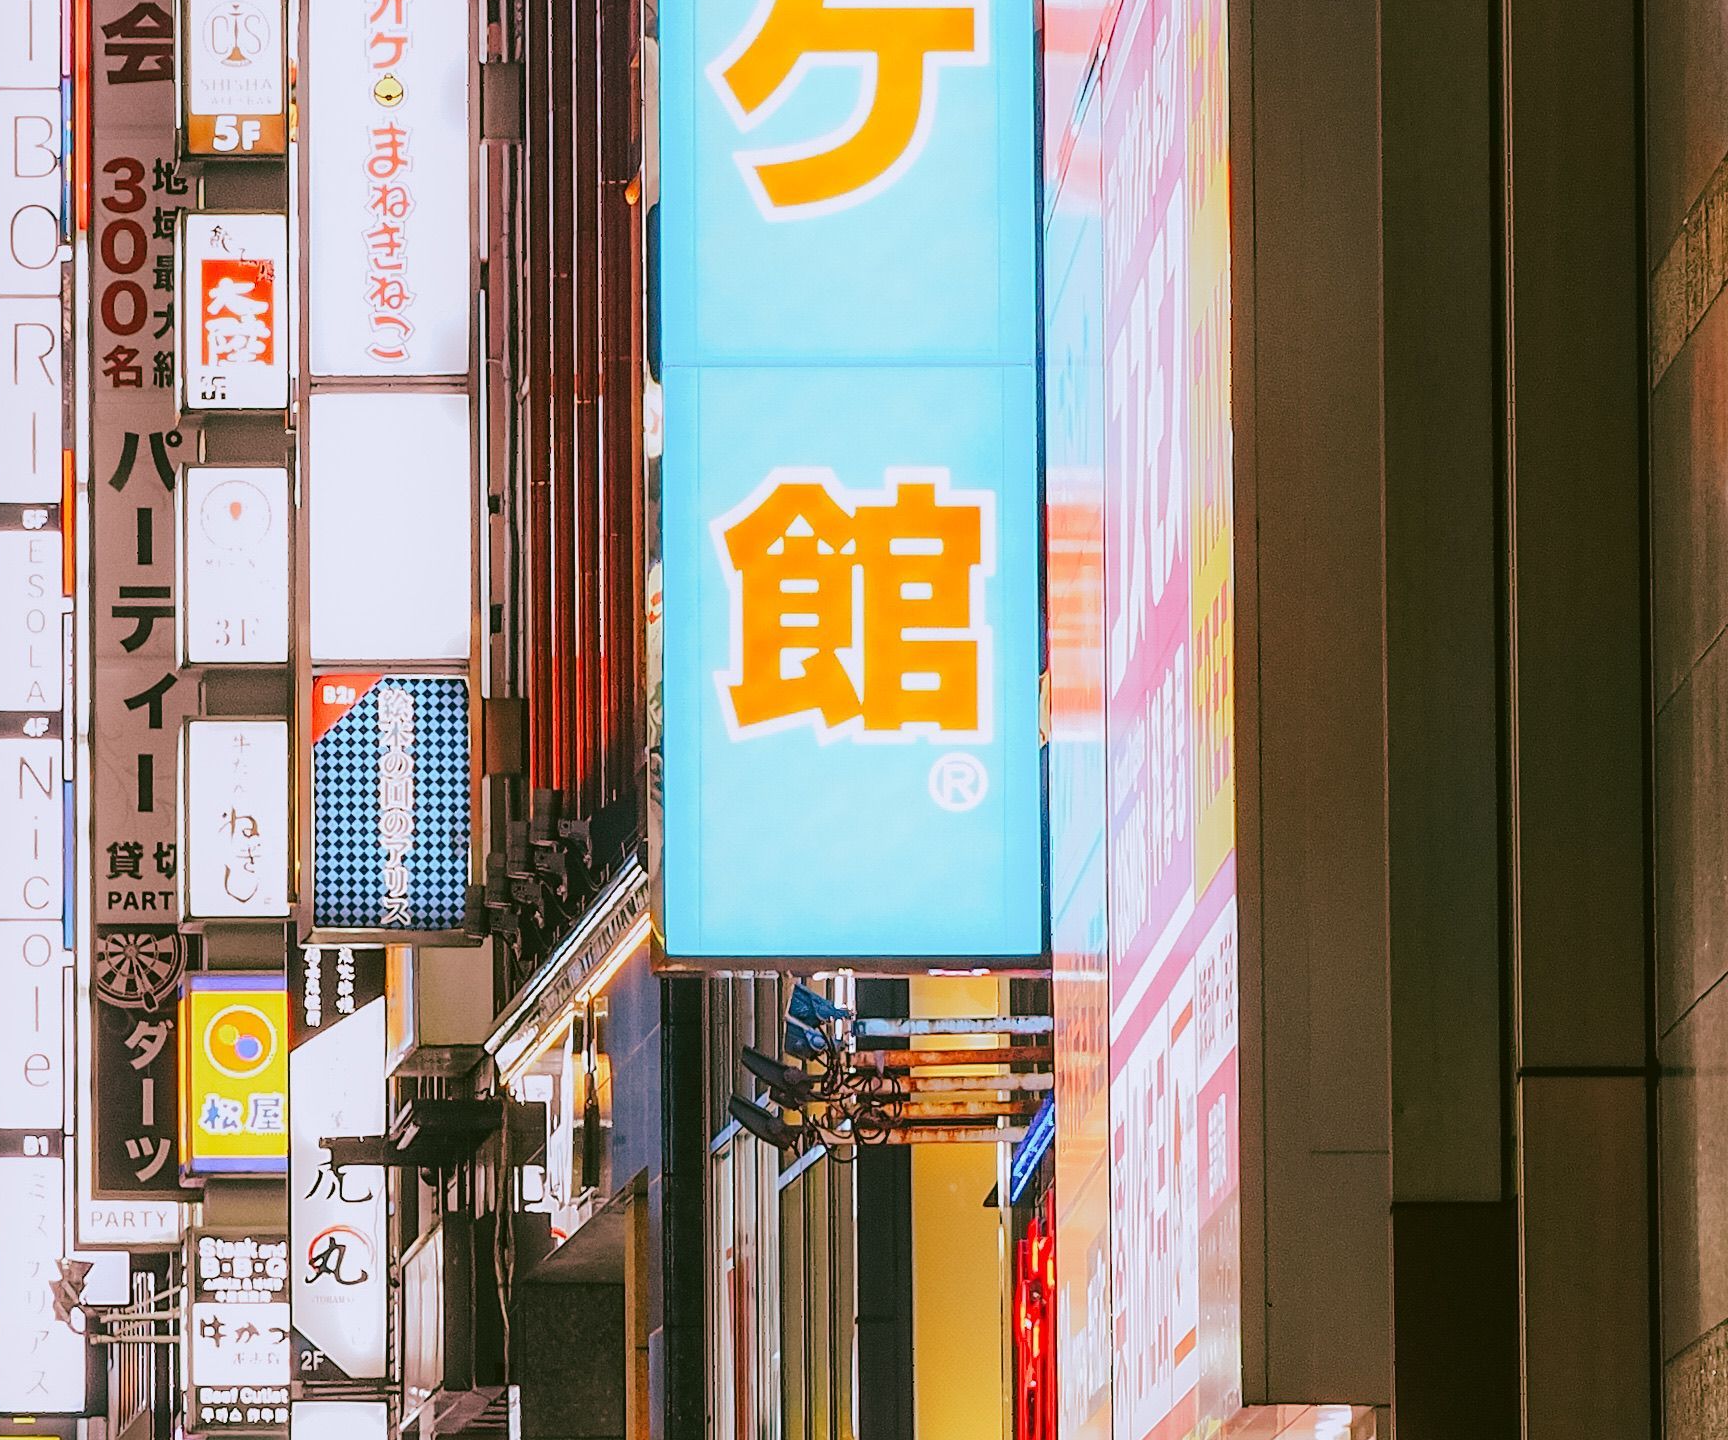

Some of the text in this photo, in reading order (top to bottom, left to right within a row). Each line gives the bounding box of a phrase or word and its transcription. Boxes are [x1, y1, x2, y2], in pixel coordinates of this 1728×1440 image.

[213, 115, 262, 152] 5F
[101, 156, 148, 389] 300名
[366, 121, 411, 359] まねきねこ
[25, 537, 47, 705] ESOLA
[108, 430, 183, 812] パーティー
[21, 714, 50, 737] 4F
[106, 841, 177, 881] 貸切
[218, 805, 261, 903] ねぎし
[124, 1019, 174, 1182] ダーツ
[201, 1096, 282, 1131] 松屋
[91, 1210, 169, 1228] PARTY
[301, 1351, 326, 1371] 2F
